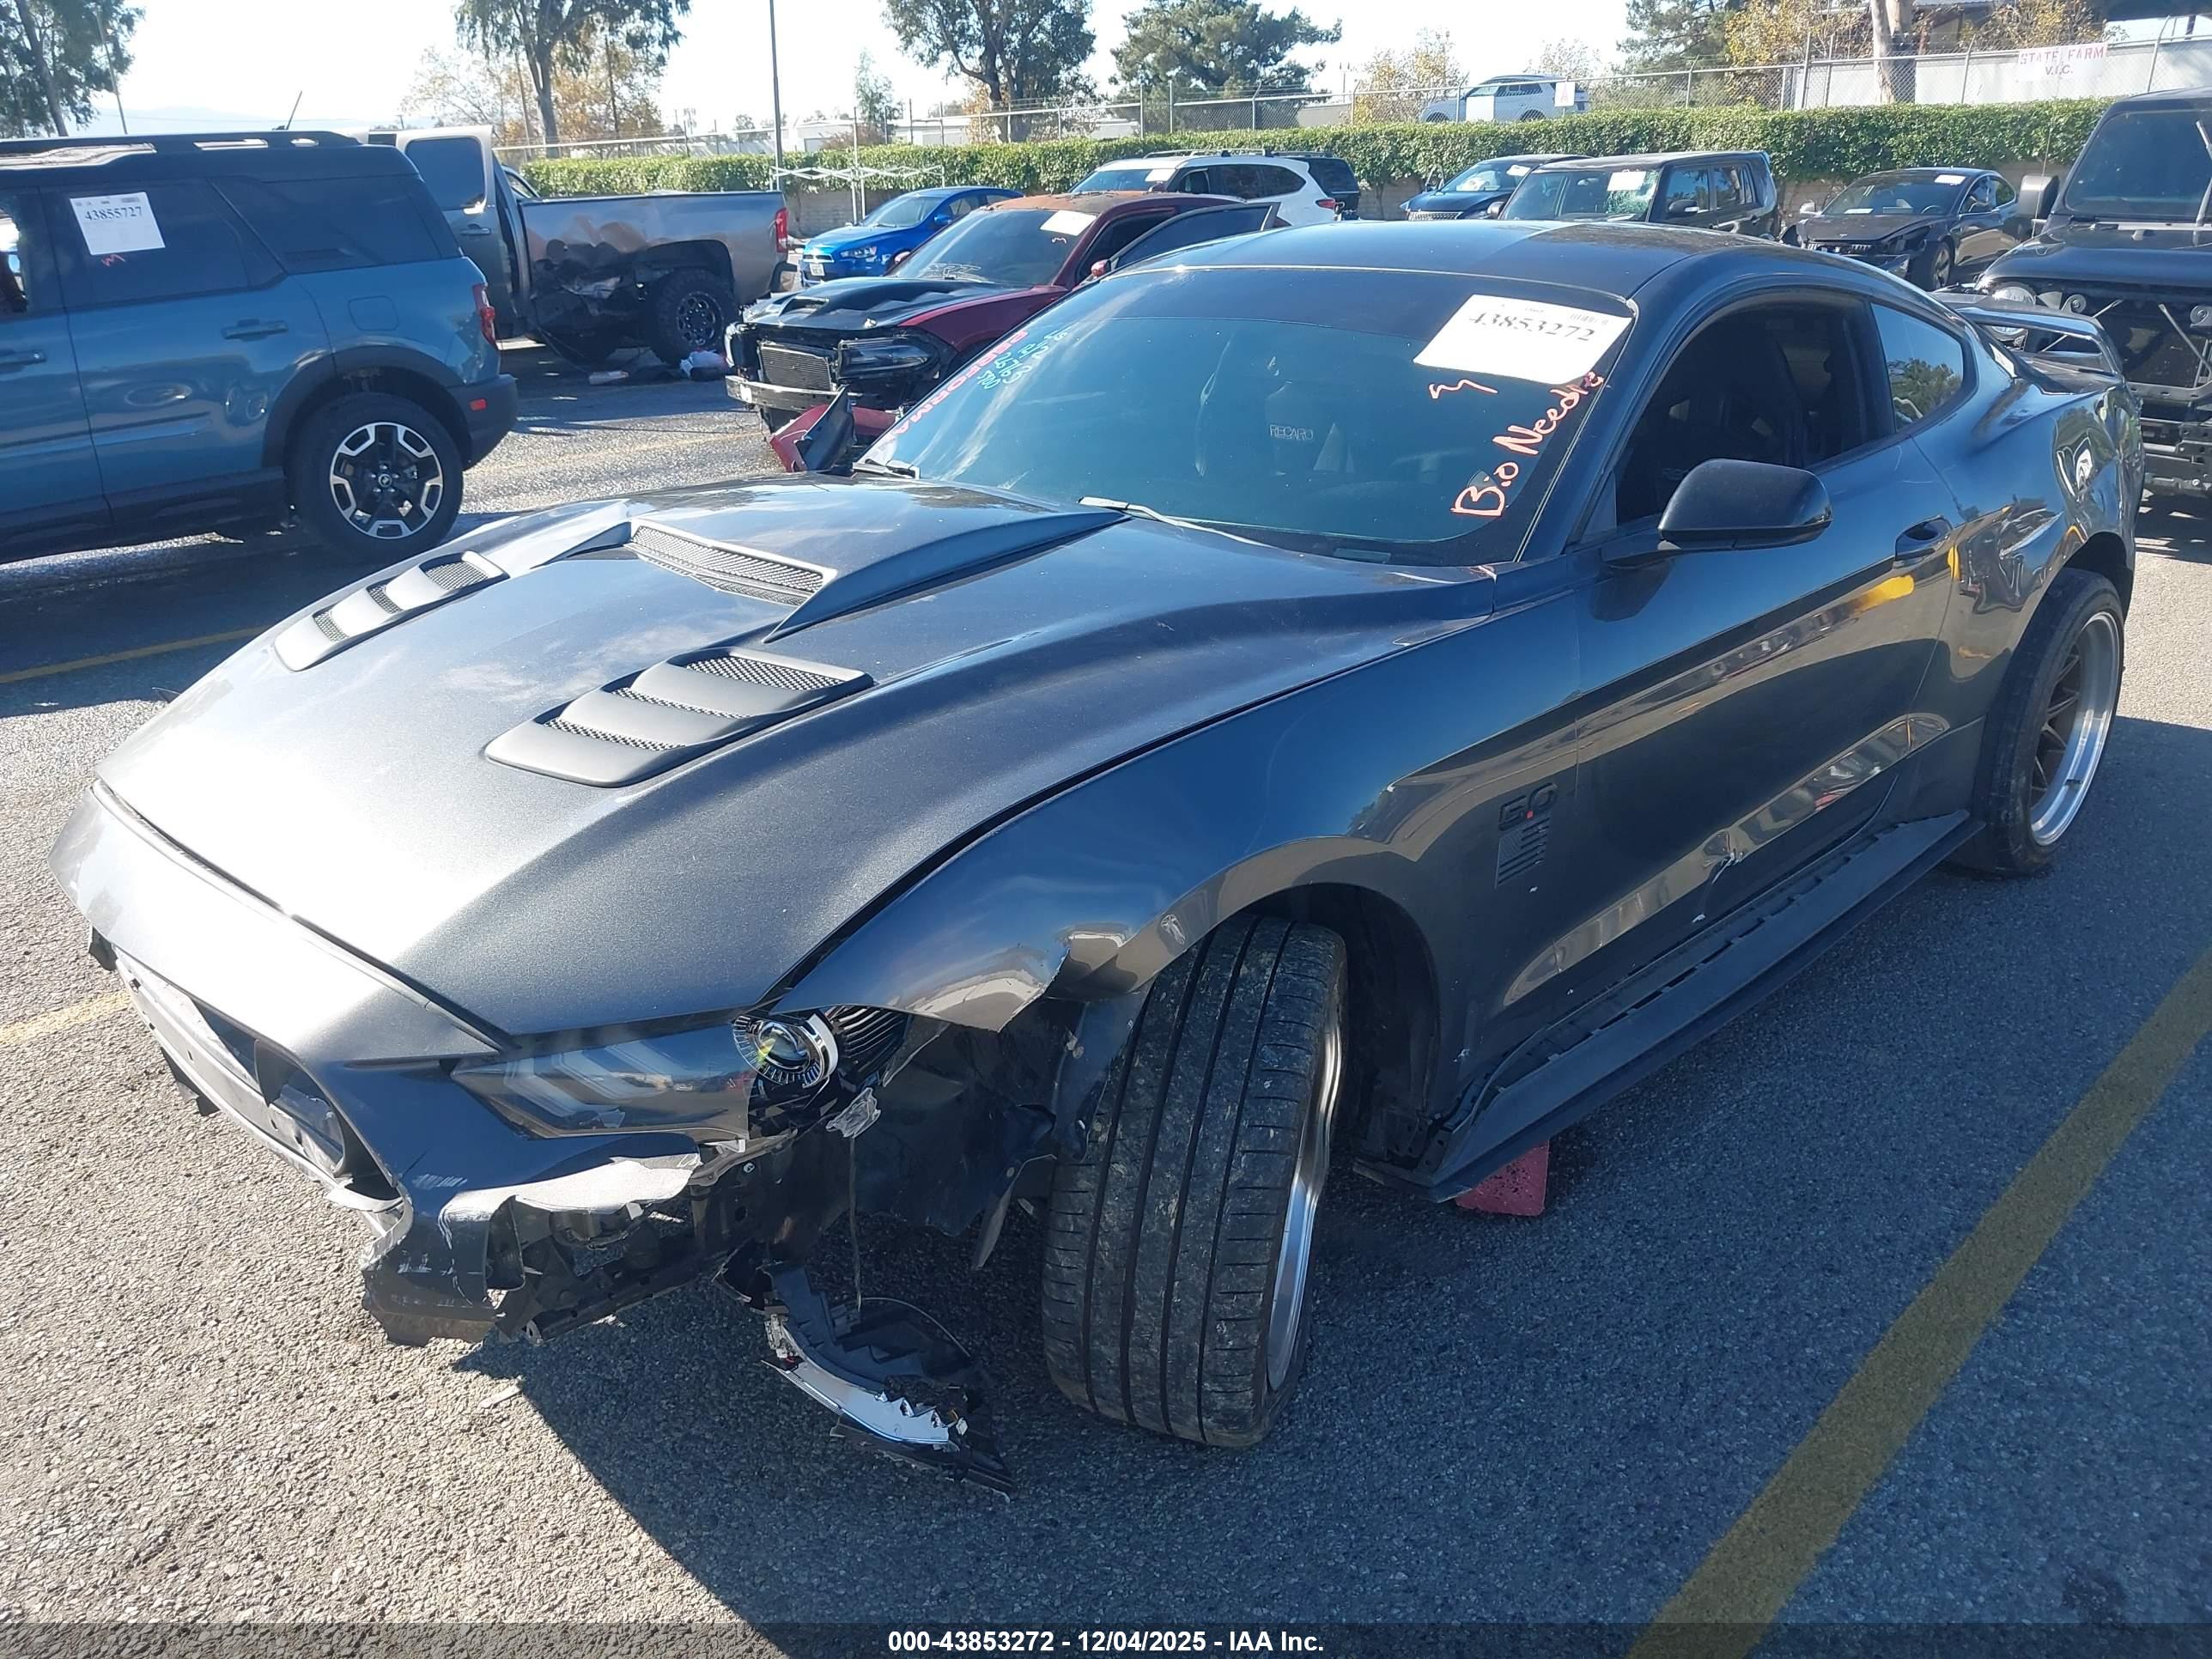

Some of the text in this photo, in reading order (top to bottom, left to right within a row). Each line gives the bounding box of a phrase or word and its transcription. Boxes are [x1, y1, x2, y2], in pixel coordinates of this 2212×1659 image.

[2020, 46, 2105, 65] STATE FARM
[84, 206, 143, 221] 43855727
[1468, 311, 1595, 342] 43853272
[1269, 424, 1315, 441] RECARO
[1450, 461, 1519, 517] Bio
